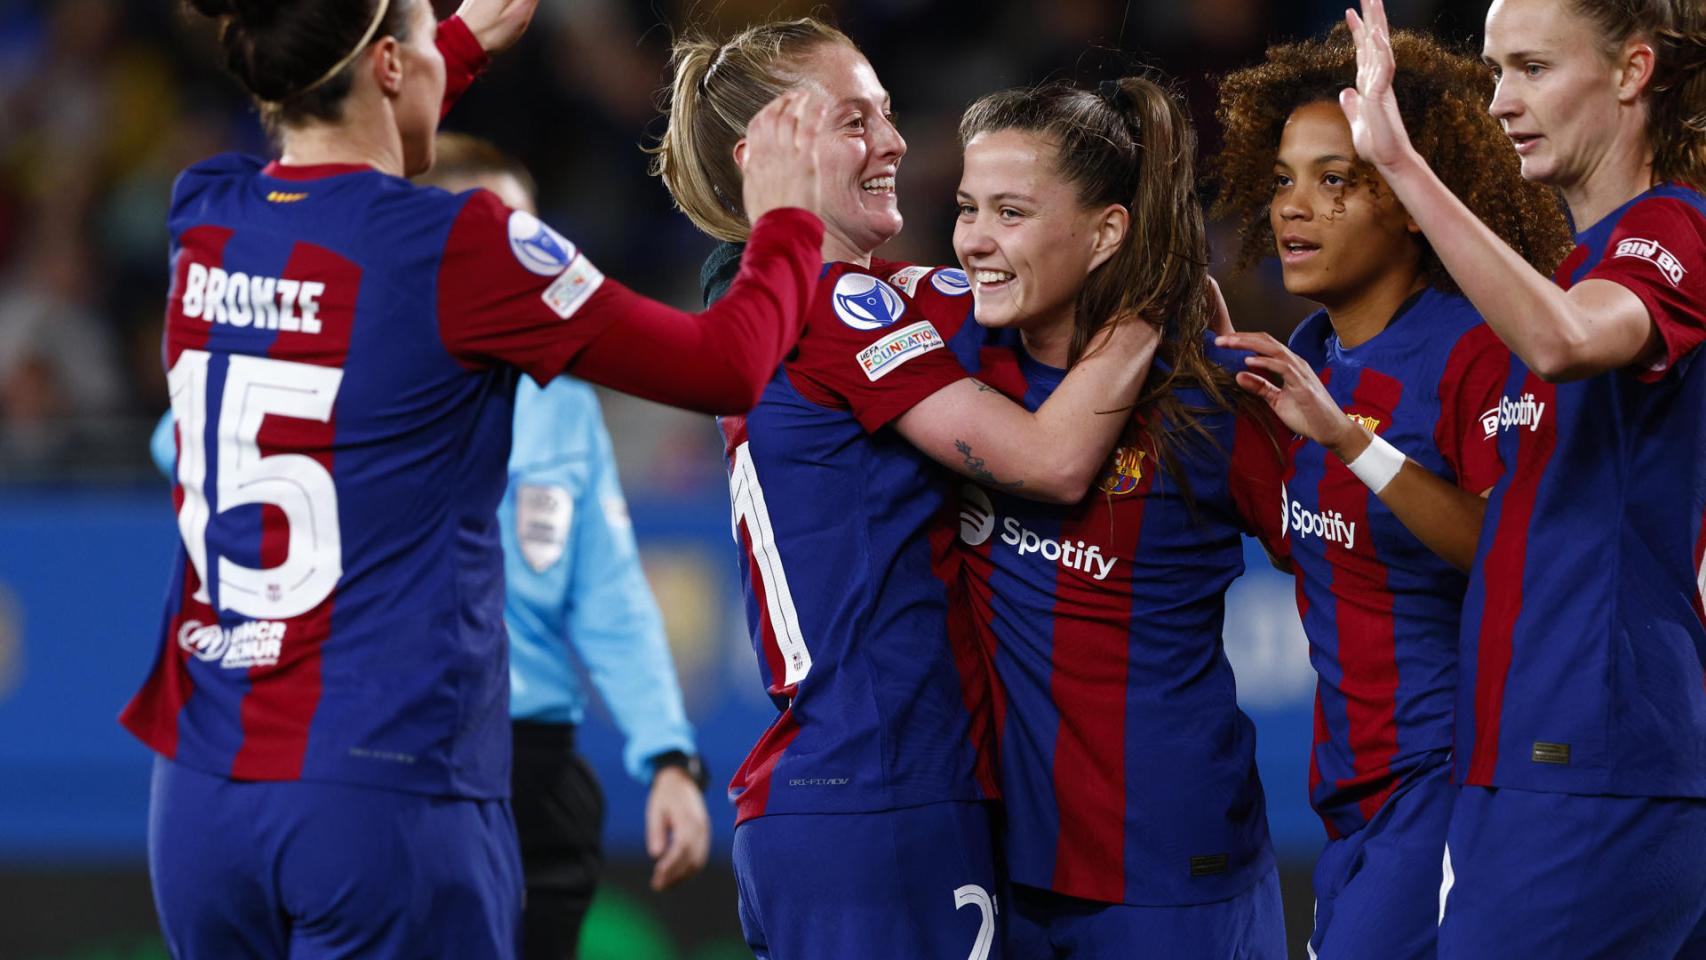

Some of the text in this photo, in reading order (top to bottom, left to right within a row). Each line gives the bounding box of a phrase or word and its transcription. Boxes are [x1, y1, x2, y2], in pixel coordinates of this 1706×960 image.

[183, 262, 325, 334] BRONZE
[860, 345, 880, 361] UEFA
[863, 328, 938, 371] FOUNDATION
[1501, 392, 1545, 432] Spotify
[167, 349, 344, 619] 15
[1000, 516, 1118, 580] Spotify
[1291, 500, 1355, 549] Spotify
[728, 441, 812, 686] 1
[953, 884, 999, 960] 2
